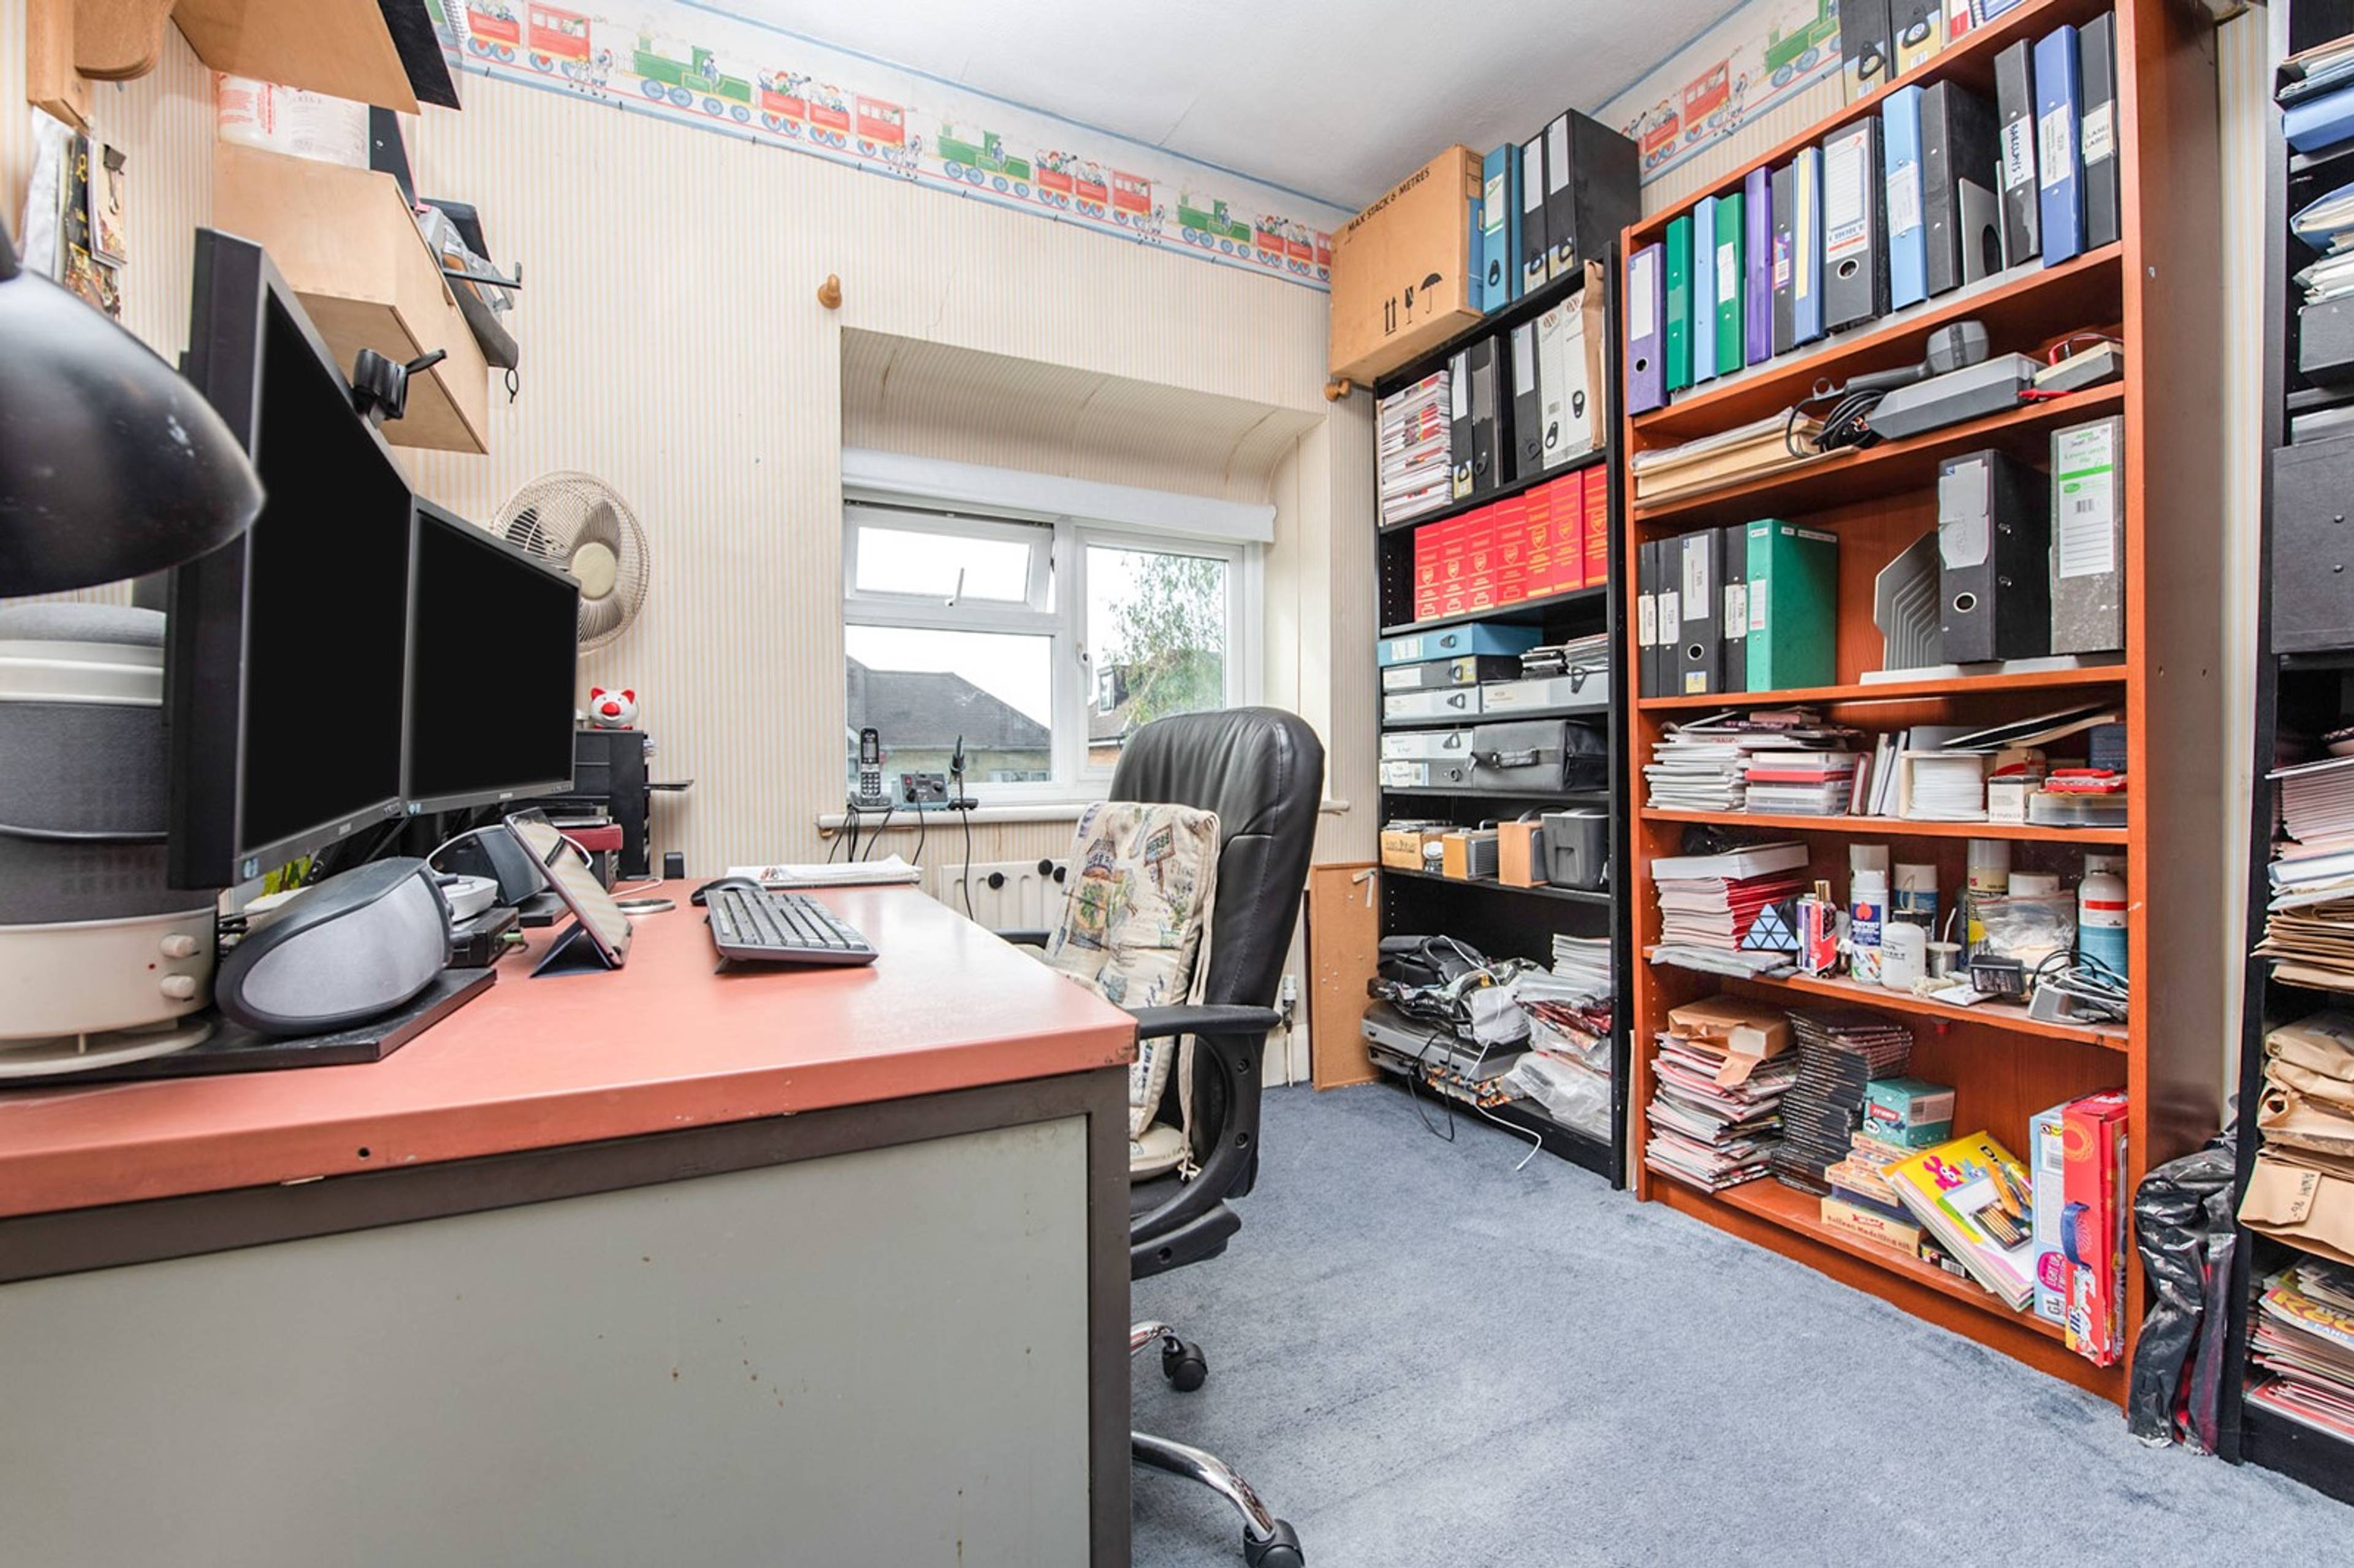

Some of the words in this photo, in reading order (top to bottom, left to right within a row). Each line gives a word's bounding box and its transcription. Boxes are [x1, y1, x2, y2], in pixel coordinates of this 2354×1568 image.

[1348, 213, 1366, 232] MAX
[1366, 194, 1390, 219] STACK
[1390, 192, 1396, 202] 6
[1398, 167, 1430, 196] METRES
